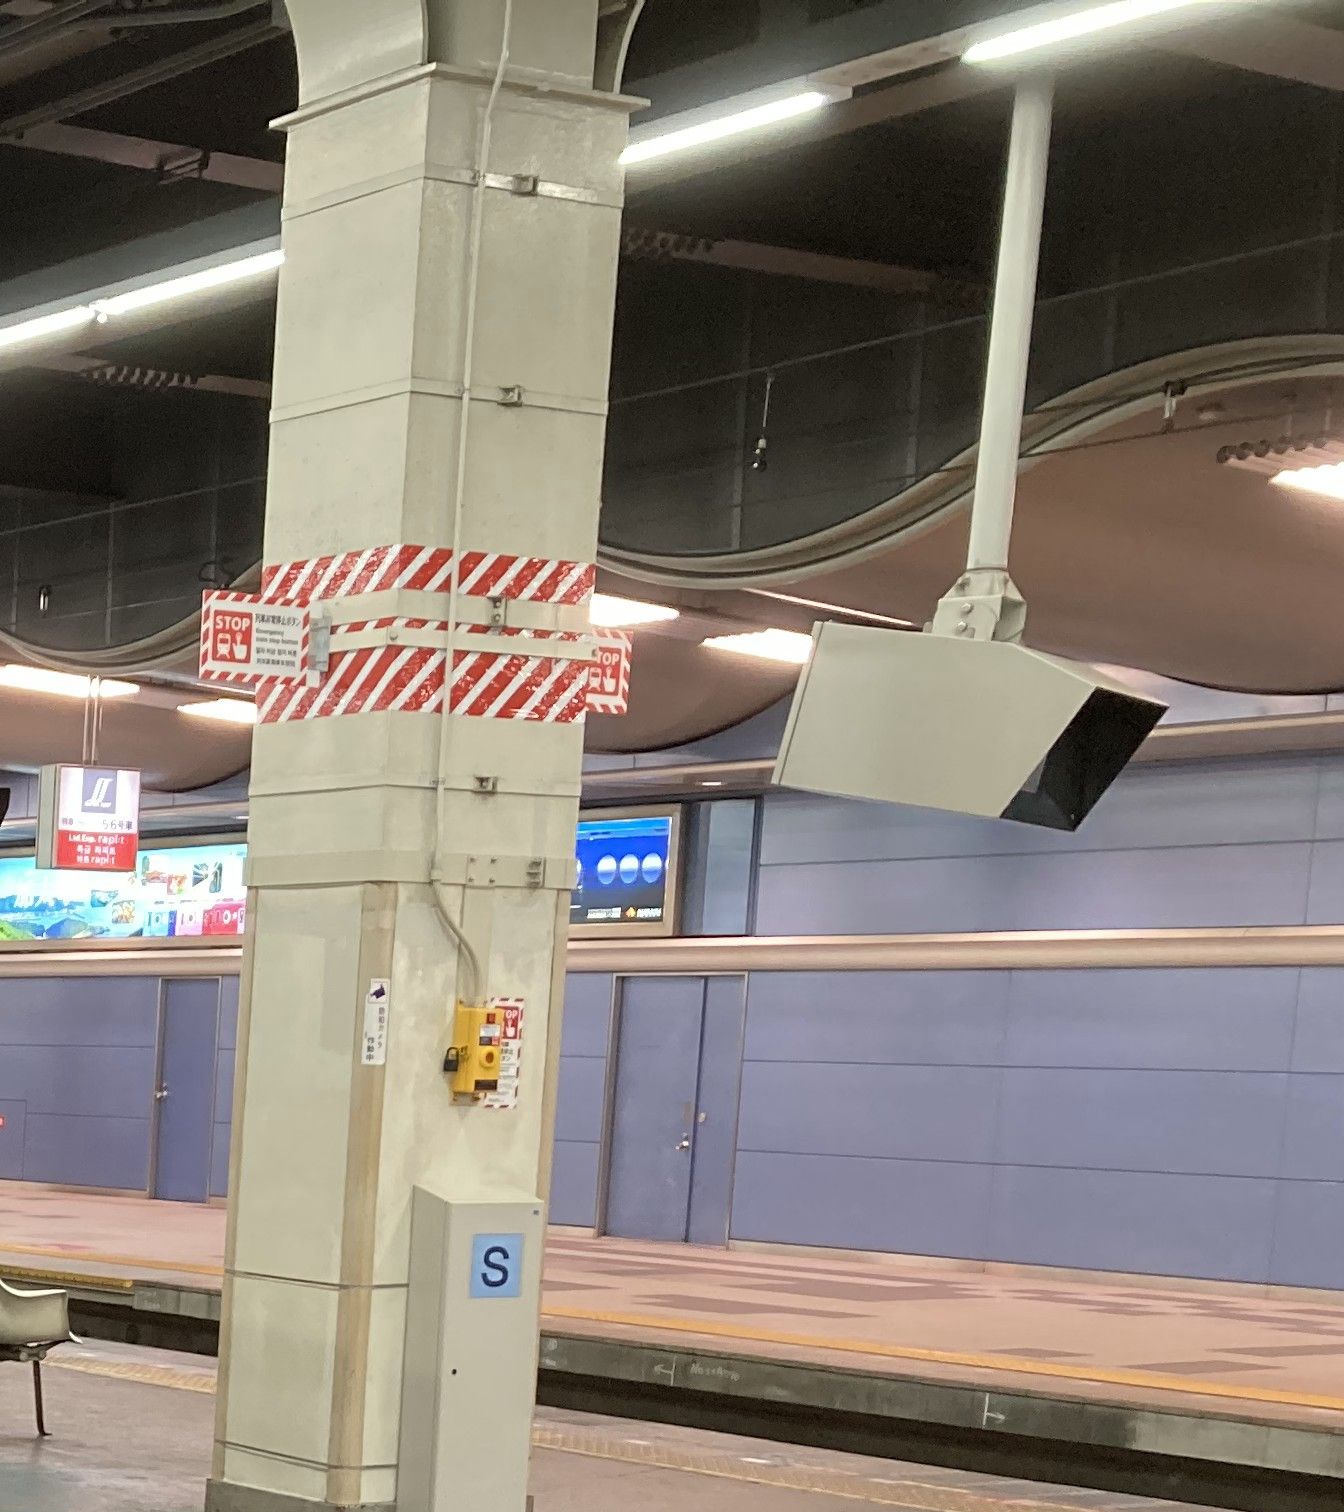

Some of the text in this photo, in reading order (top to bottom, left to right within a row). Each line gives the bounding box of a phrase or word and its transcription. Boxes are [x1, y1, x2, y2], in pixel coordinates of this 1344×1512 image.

[215, 614, 251, 632] STOP
[596, 652, 620, 666] TOP
[481, 1246, 510, 1288] S
